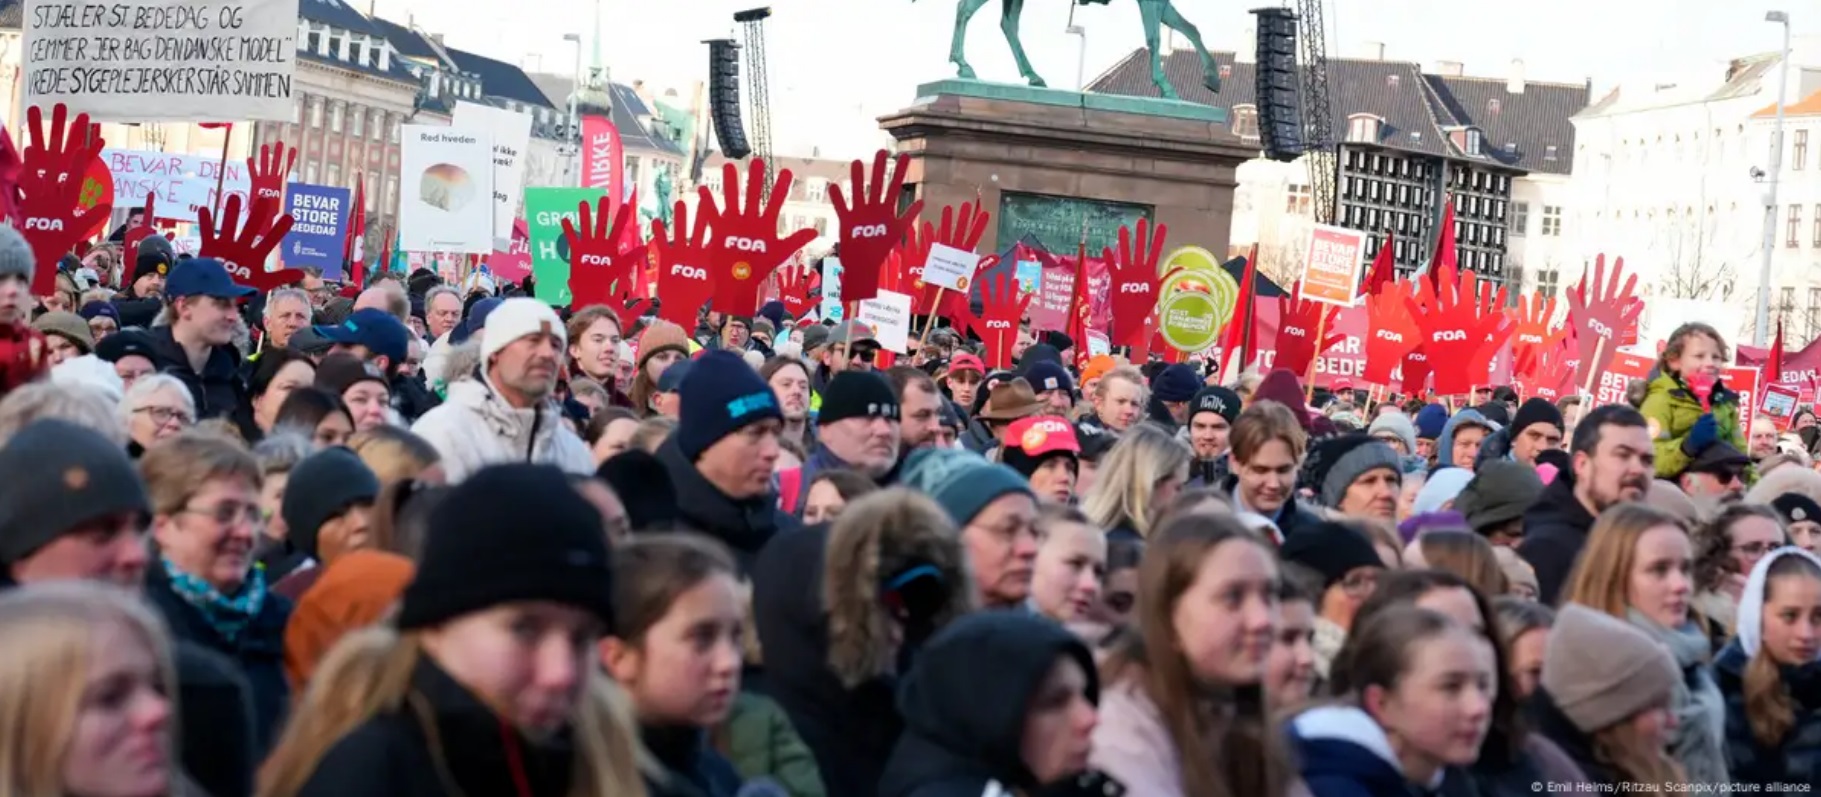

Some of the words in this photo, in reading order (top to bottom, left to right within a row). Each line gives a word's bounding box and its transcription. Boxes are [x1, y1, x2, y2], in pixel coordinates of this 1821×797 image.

[32, 4, 107, 29] STJÆLER
[107, 4, 131, 27] ST.
[133, 5, 209, 29] BEDEDAG
[219, 6, 243, 29] OG
[29, 37, 89, 63] GEMMER
[91, 37, 120, 61] JER
[123, 37, 151, 60] BAG
[184, 36, 236, 61] DANSKE
[28, 67, 70, 96] VREDE
[70, 66, 195, 95] SYGEPLEJERSKER
[197, 64, 230, 95] STÅR
[232, 69, 290, 98] SAMMEN
[420, 133, 440, 142] Red
[442, 134, 477, 144] hveden
[111, 153, 183, 176] BEVAR
[198, 161, 240, 182] DEN
[293, 193, 341, 211] BEVAR
[24, 217, 64, 231] FOA
[291, 208, 338, 226] STORE
[850, 224, 888, 239] FOA
[724, 235, 767, 253] FOA
[581, 254, 613, 267] FOA
[670, 264, 708, 281] FOA
[908, 266, 925, 275] FO
[1120, 282, 1151, 294] FOA
[784, 294, 802, 305] FOA
[986, 320, 1012, 329] FOA
[1284, 325, 1307, 338] FOA
[1587, 317, 1614, 340] FOA
[1376, 328, 1404, 343] FOA
[1432, 329, 1468, 343] FOA
